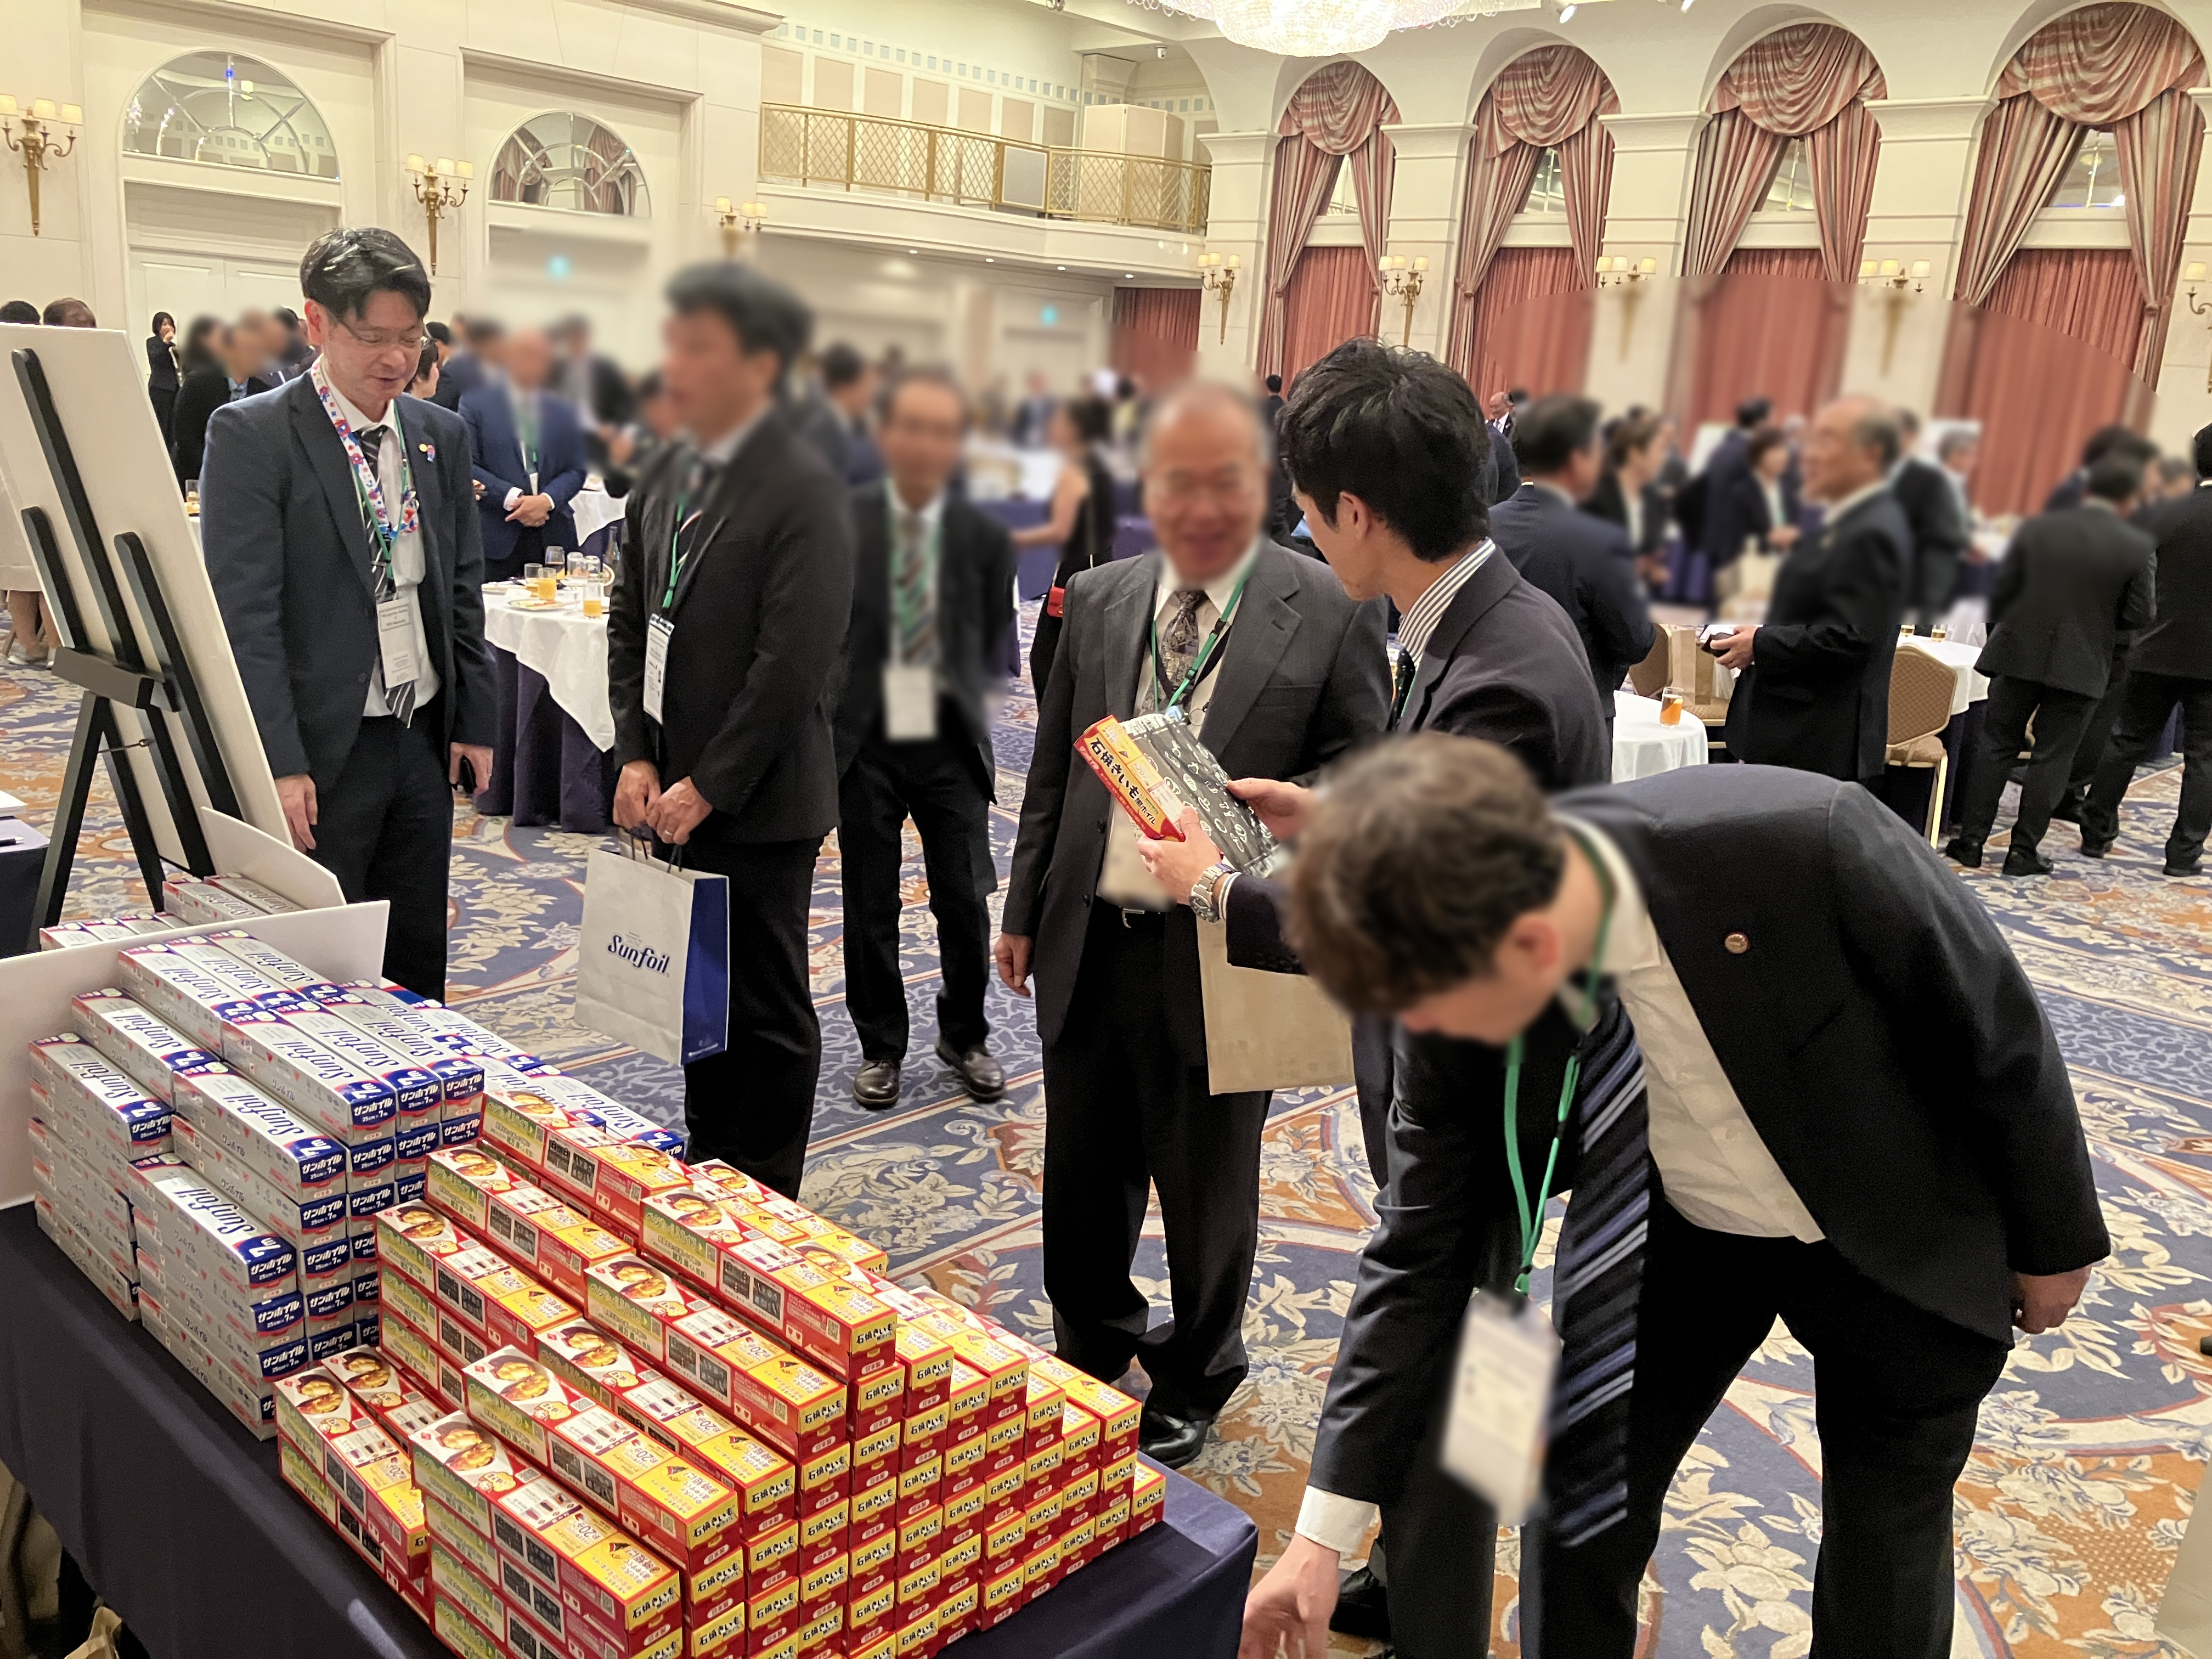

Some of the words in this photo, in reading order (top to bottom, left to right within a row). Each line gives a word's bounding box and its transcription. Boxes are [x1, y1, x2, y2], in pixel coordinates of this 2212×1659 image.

[1091, 737, 1139, 799] 石焼きいも
[1135, 798, 1155, 825] 黒ホイル
[199, 894, 255, 915] Sunfoil
[608, 935, 670, 974] Sunfoil
[201, 960, 272, 989] Sunfoil
[244, 953, 314, 982] Sunfoil
[160, 968, 230, 1000] Sunfoil
[376, 1003, 439, 1032] Sunfoil
[112, 1014, 182, 1049] Sunfoil
[363, 1022, 444, 1057] Sunfoil
[443, 1024, 510, 1053] Sunfoil
[319, 1030, 400, 1066] Sunfoil
[273, 1042, 354, 1079] Sunfoil
[67, 1062, 139, 1098] Sunfoil
[446, 1074, 482, 1091] サンホイル
[400, 1084, 438, 1102] サンホイル
[222, 1094, 304, 1136] Sunfoil
[354, 1097, 393, 1117] サンホイル
[565, 1093, 645, 1128] Sunfoil
[132, 1114, 171, 1133] サンホイル
[443, 1117, 481, 1137] サンホイル
[398, 1132, 436, 1151] サンホイル
[302, 1153, 343, 1175] サンホイル
[353, 1144, 392, 1163] サンホイル
[352, 1188, 391, 1207] サンホイル
[173, 1187, 256, 1235] Sunfoil
[303, 1199, 343, 1220] サンホイル
[251, 1254, 292, 1274] サンホイル
[307, 1245, 347, 1265] サンホイル
[310, 1286, 350, 1307] サンホイル
[258, 1301, 300, 1323] サンホイル
[314, 1331, 353, 1352] サンホイル
[856, 1323, 893, 1344] 石焼きいも
[263, 1345, 305, 1367] サンホイル
[917, 1359, 950, 1379] 石焼きいも
[995, 1370, 1025, 1389] 石焼きいも
[866, 1379, 900, 1400] 石焼きいも
[804, 1399, 840, 1424] 石焼きいも
[955, 1391, 985, 1411] 石焼きいも
[1033, 1401, 1062, 1420] 石焼きいも
[911, 1413, 944, 1434] 石焼きいも
[991, 1423, 1021, 1443] 石焼きいも
[1111, 1414, 1137, 1432] 石焼きいも
[860, 1434, 895, 1456] 石焼きいも
[1069, 1431, 1096, 1451] 石焼きいも
[951, 1445, 982, 1465] 石焼きいも
[1031, 1452, 1059, 1471] 石焼きいも
[808, 1456, 844, 1480] 石焼きいも
[904, 1465, 938, 1488] 石焼きいも
[1107, 1463, 1135, 1482] 石焼きいも
[752, 1479, 790, 1503] 石焼きいも
[991, 1474, 1020, 1494] 石焼きいも
[1066, 1481, 1093, 1500] 石焼きいも
[857, 1489, 891, 1512] 石焼きいも
[950, 1497, 980, 1518] 石焼きいも
[1137, 1488, 1161, 1508] 石焼きいも
[693, 1508, 732, 1537] 石焼きいも
[808, 1512, 844, 1536] 石焼きいも
[1030, 1503, 1058, 1523] 石焼きいも
[1100, 1509, 1126, 1527] 石焼きいも
[906, 1519, 938, 1542] 石焼きいも
[993, 1527, 1023, 1548] 石焼きいも
[1064, 1528, 1091, 1549] 石焼きいも
[755, 1536, 793, 1561] 石焼きいも
[857, 1543, 890, 1566] 石焼きいも
[946, 1545, 977, 1567] 石焼きいも
[1029, 1553, 1057, 1575] 石焼きいも
[698, 1562, 738, 1592] 石焼きいも
[808, 1566, 843, 1590] 石焼きいも
[904, 1571, 936, 1594] 石焼きいも
[990, 1576, 1020, 1599] 石焼きいも
[633, 1587, 674, 1619] 石焼きいも
[756, 1593, 793, 1620] 石焼きいも
[856, 1594, 890, 1619] 石焼きいも
[943, 1595, 973, 1618] 石焼きいも
[700, 1616, 738, 1645] 石焼きいも
[803, 1615, 838, 1641] 石焼きいも
[902, 1621, 934, 1645] 石焼きいも
